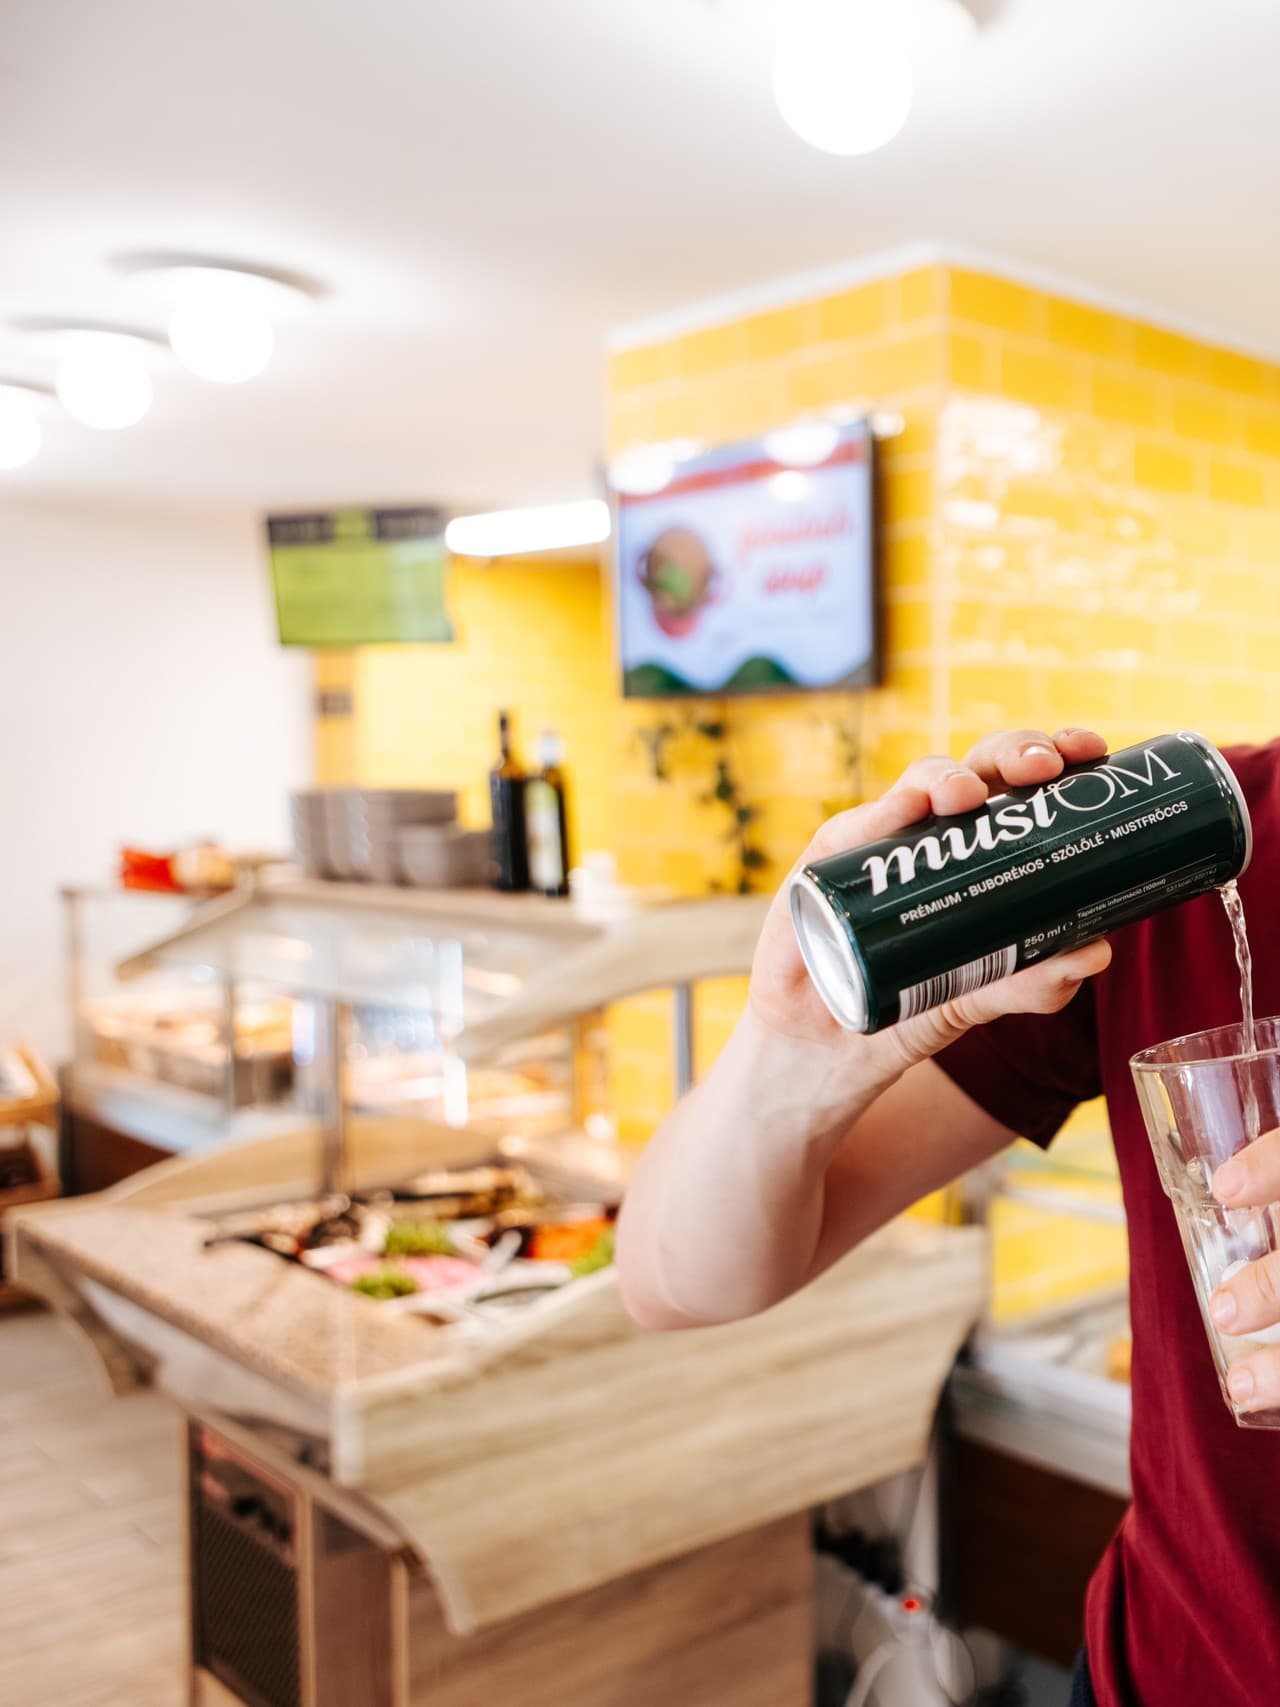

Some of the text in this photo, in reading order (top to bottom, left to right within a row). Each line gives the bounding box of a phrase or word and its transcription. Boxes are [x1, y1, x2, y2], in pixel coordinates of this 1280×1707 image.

[861, 746, 1183, 897] mustOM
[900, 892, 962, 924] PRÉMIUM
[968, 856, 1045, 897] BUBORÉKOS
[1109, 800, 1189, 840] MUSTFRÖCCS
[1024, 933, 1045, 948] 250
[1047, 924, 1061, 940] ml
